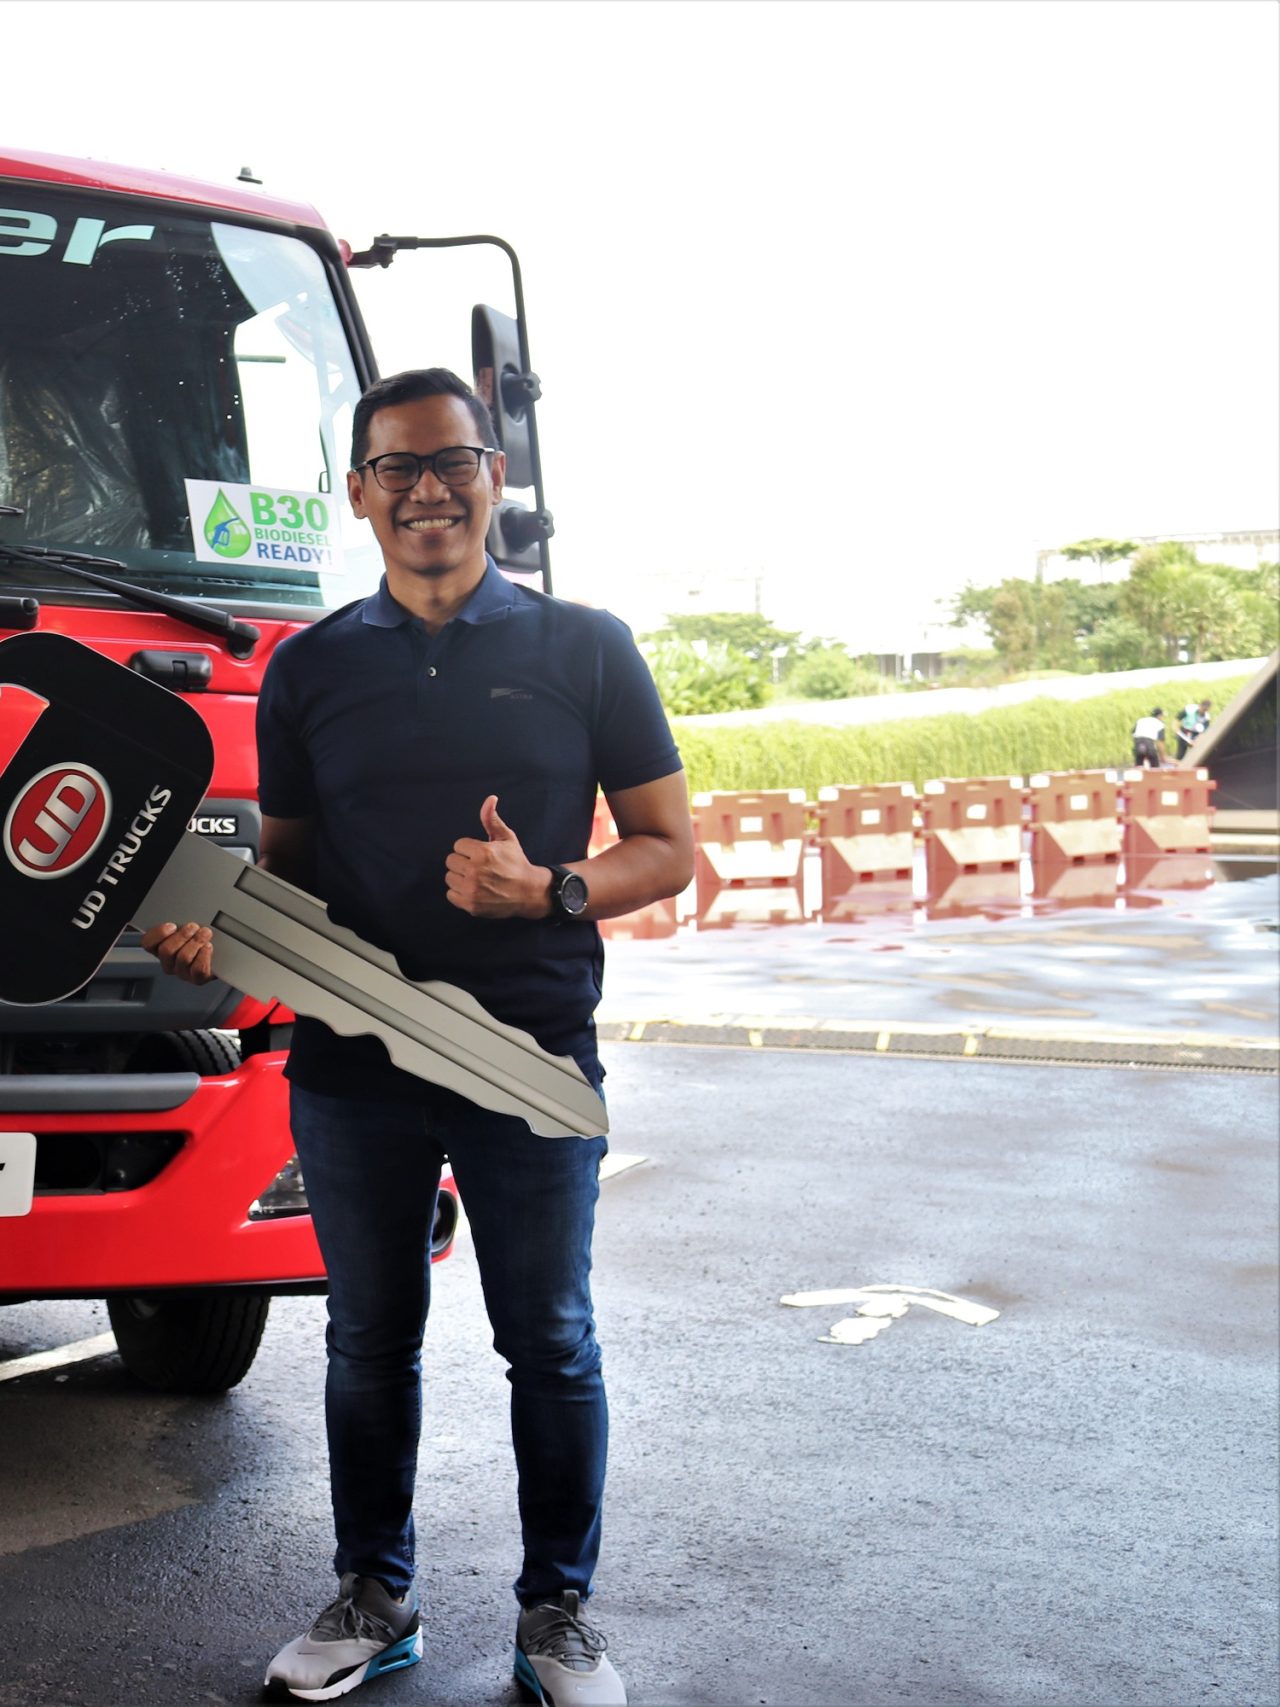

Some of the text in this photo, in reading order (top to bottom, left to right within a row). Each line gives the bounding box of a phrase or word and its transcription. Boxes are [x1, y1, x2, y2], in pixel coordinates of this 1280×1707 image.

[250, 492, 329, 531] B30
[255, 528, 332, 546] BIODIESEL
[257, 543, 332, 564] READY!
[187, 818, 236, 834] UCKS
[72, 785, 172, 930] UD TRUCKS
